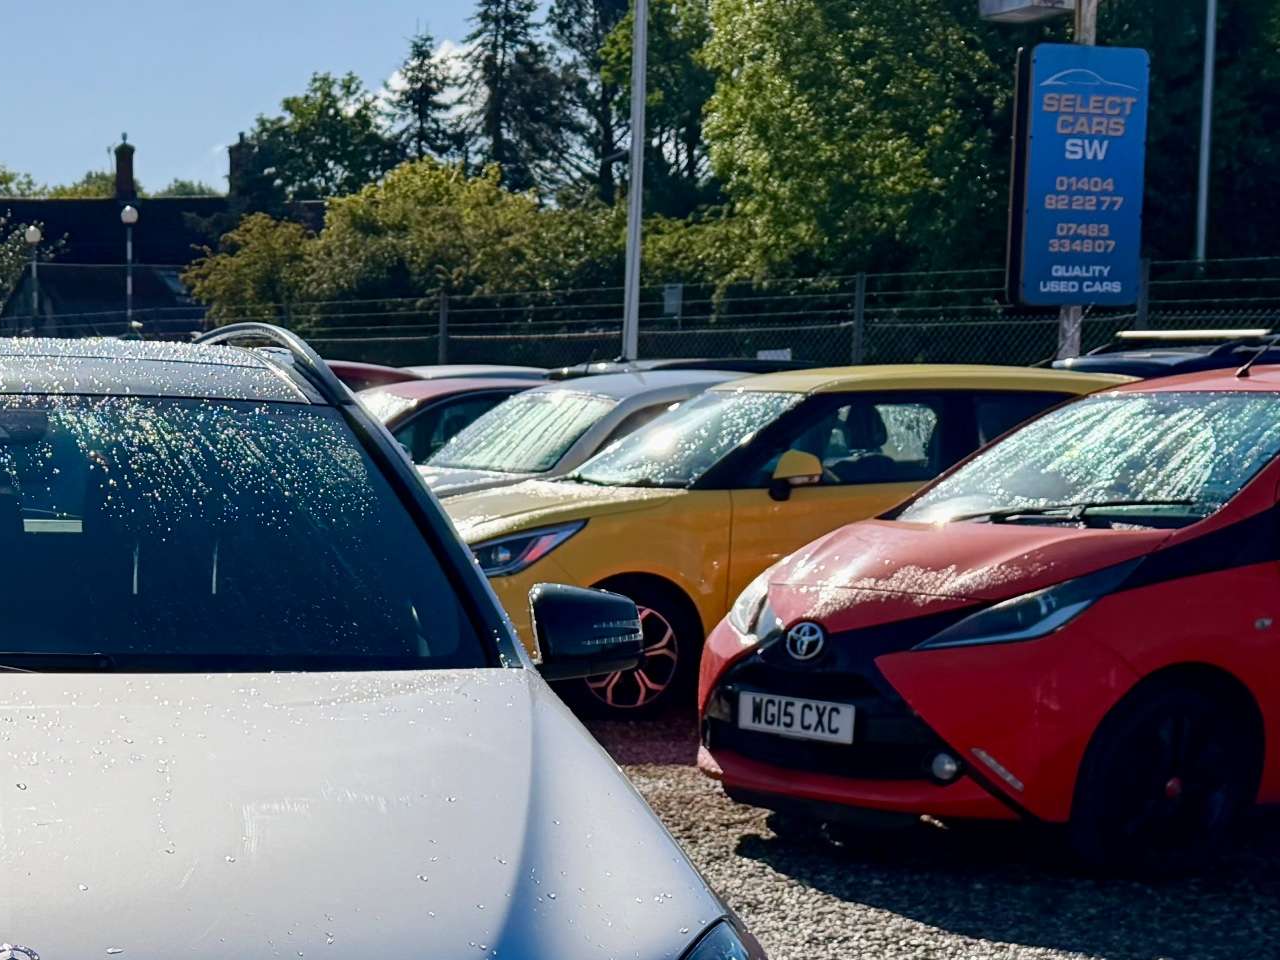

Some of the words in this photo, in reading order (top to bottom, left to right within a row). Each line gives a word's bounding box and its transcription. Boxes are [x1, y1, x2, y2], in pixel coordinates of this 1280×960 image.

[1042, 93, 1137, 115] SELECT
[1056, 115, 1125, 136] CARS
[1065, 138, 1109, 160] SW
[1055, 176, 1114, 192] 01404
[1056, 223, 1110, 237] 07483
[1048, 239, 1116, 253] 334807
[1051, 265, 1110, 277] QUALITY
[1040, 281, 1079, 293] USED
[1082, 281, 1122, 293] CARS
[751, 696, 794, 728] WG15
[800, 701, 841, 734] CXC
